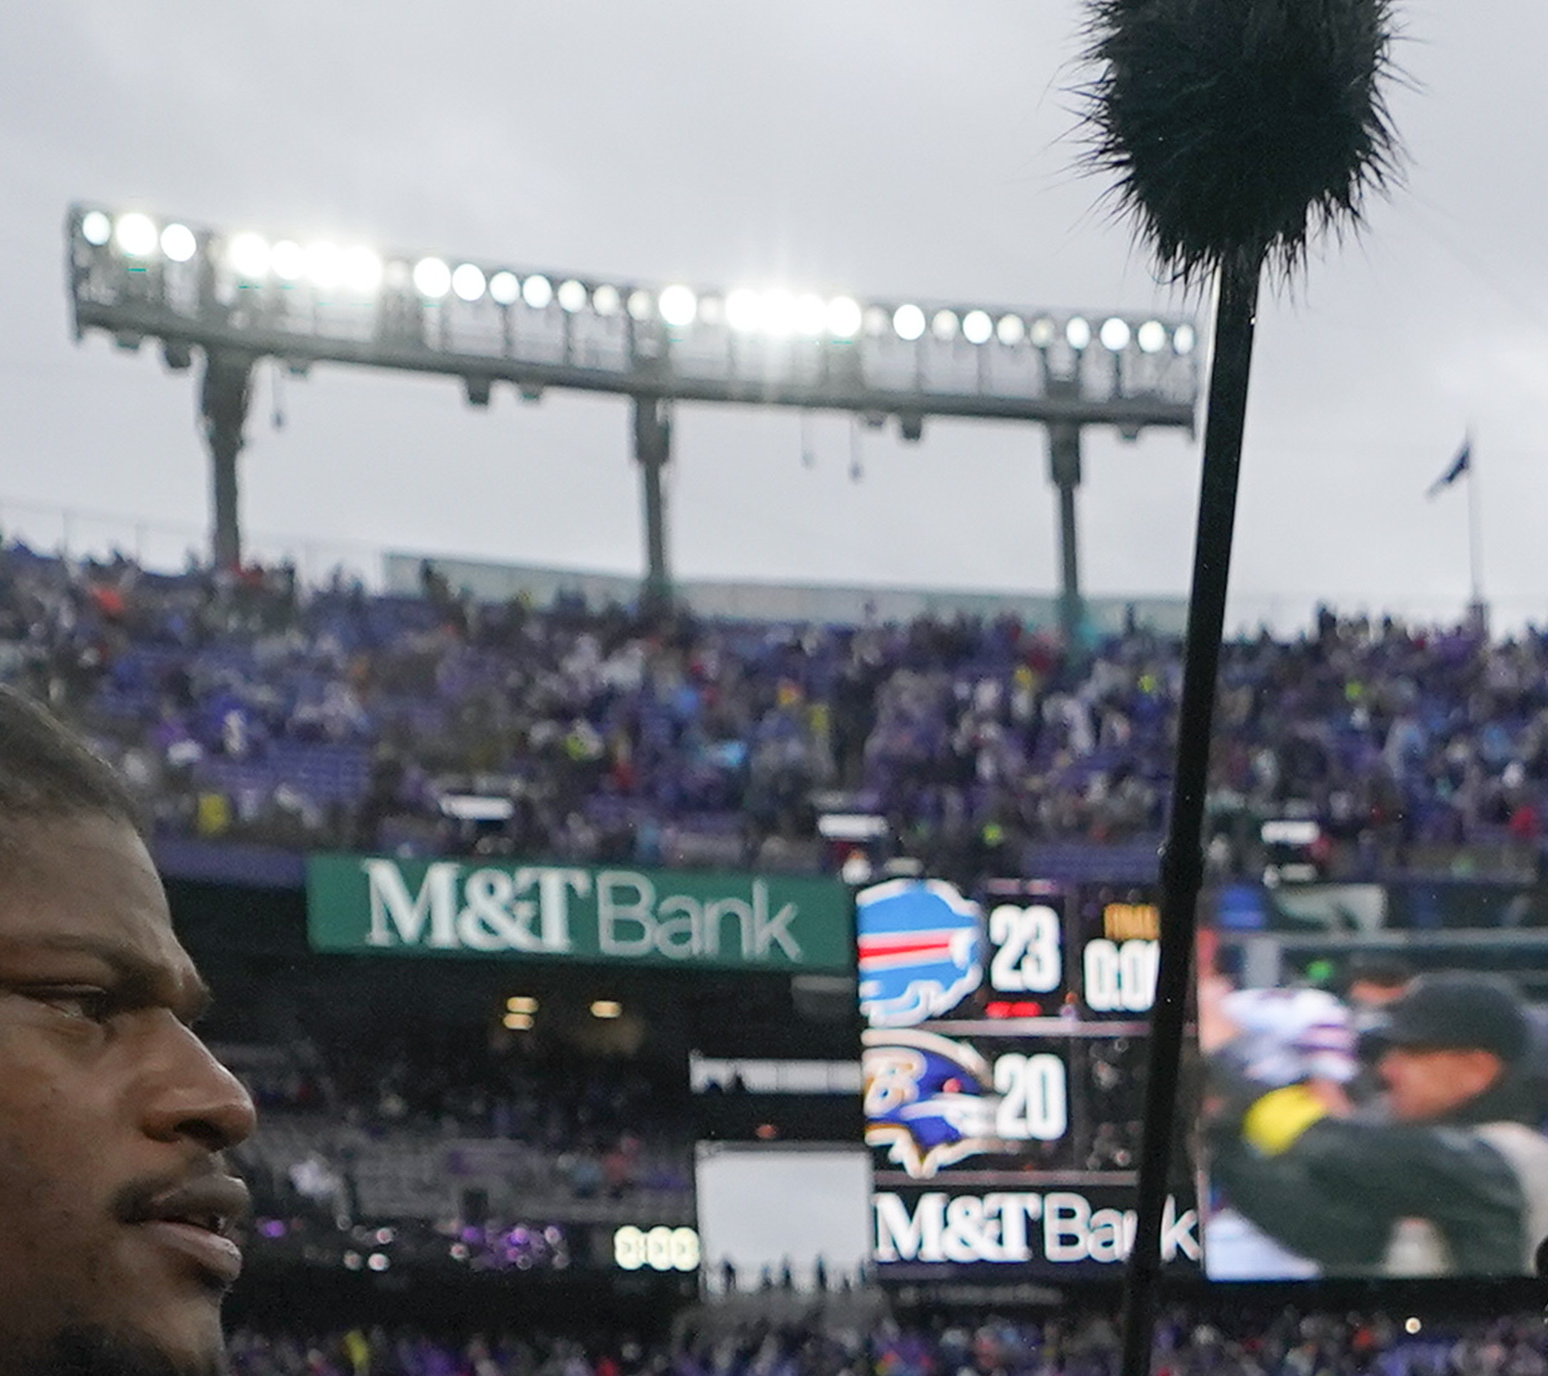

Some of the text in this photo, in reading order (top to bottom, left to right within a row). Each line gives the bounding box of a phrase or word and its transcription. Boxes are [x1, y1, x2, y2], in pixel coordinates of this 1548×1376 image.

[362, 858, 803, 961] M&T Bank
[989, 904, 1062, 993] 23
[994, 1053, 1067, 1141] 20
[873, 1191, 1043, 1263] M&T
